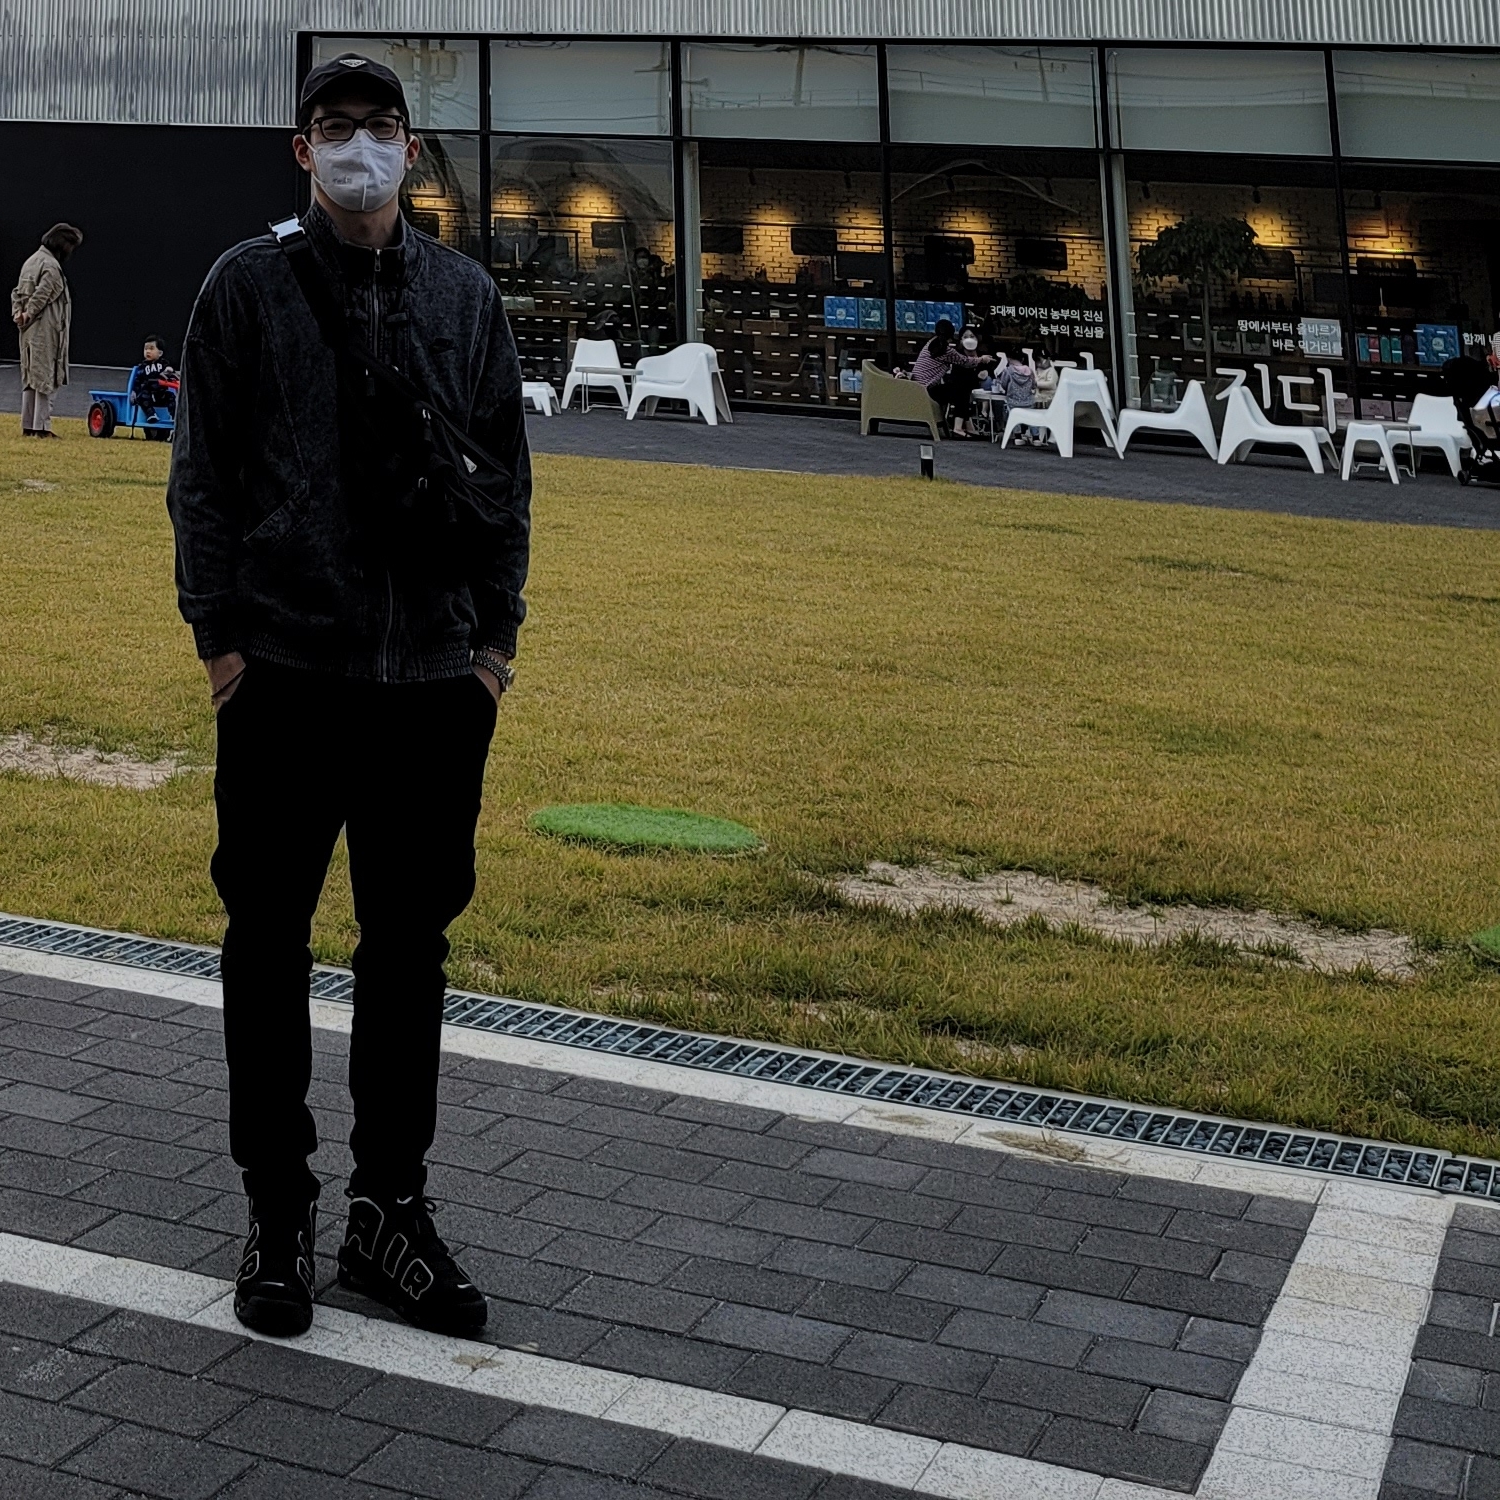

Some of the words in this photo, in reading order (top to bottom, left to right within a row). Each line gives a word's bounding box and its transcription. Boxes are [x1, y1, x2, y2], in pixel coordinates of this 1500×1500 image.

[989, 305, 1016, 317] 3대째
[1018, 306, 1048, 319] 이어진
[1050, 308, 1081, 321] 농부의
[1083, 310, 1104, 322] 진심
[1039, 324, 1070, 336] 농부의
[1073, 326, 1105, 339] 진심을
[1237, 319, 1293, 335] 땅에서부터
[1272, 339, 1296, 352] 바른
[1462, 332, 1485, 346] 함께
[346, 1197, 434, 1300] AIR
